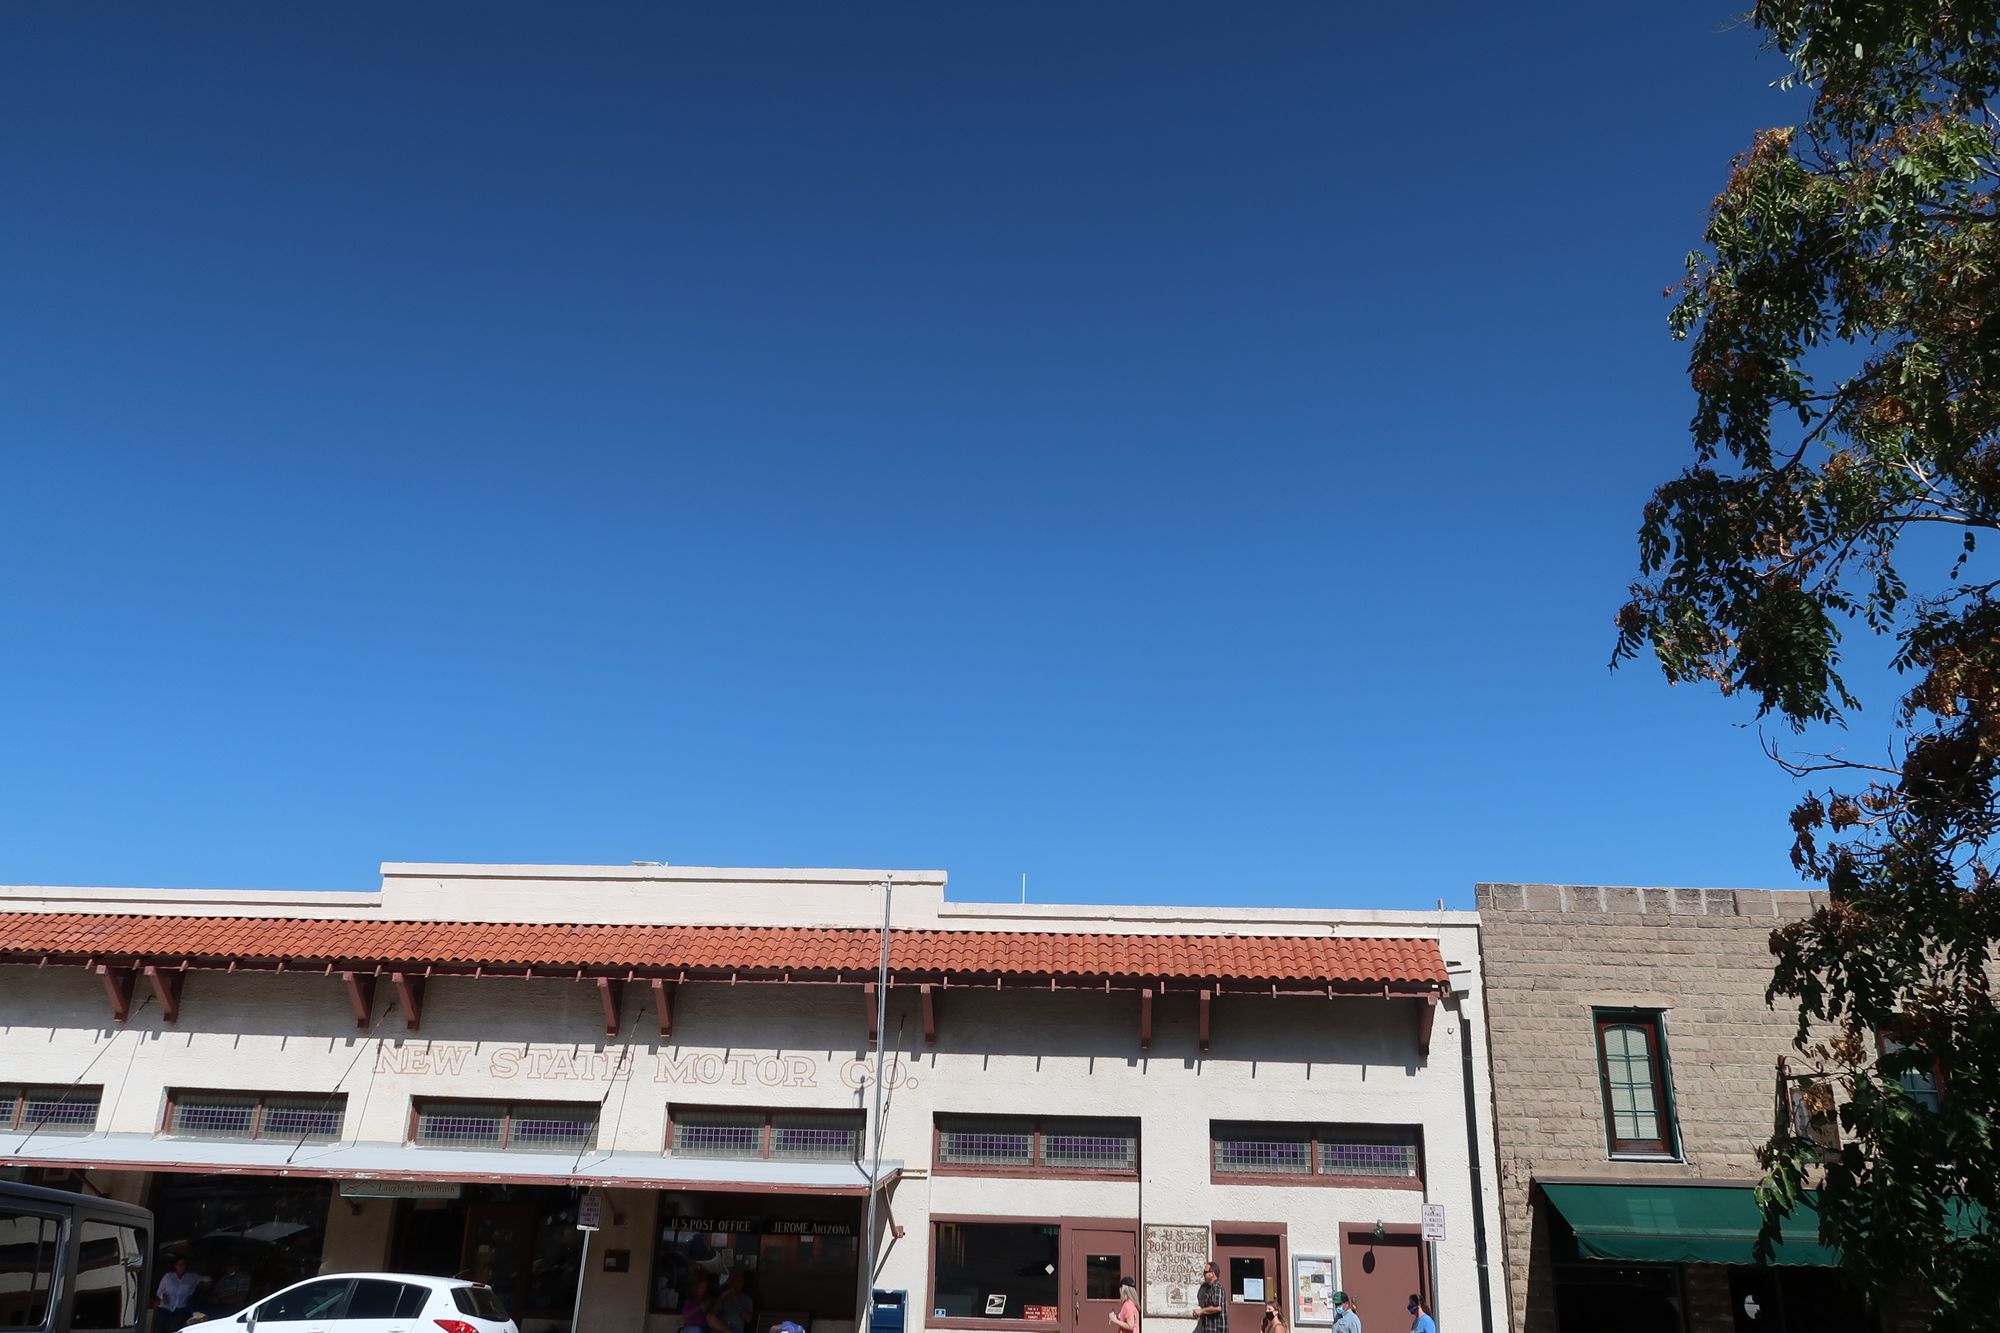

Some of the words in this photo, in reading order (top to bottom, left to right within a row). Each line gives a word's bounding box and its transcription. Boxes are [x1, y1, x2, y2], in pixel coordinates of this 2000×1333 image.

[374, 1043, 472, 1076] NEW
[490, 1047, 634, 1081] STATE
[654, 1052, 817, 1088] MOTOR
[840, 1056, 919, 1090] CO.
[417, 1184, 455, 1193] Mountain
[718, 1219, 751, 1232] OFFICE
[1149, 1241, 1172, 1253] POST
[1155, 1264, 1196, 1274] ARIZONA
